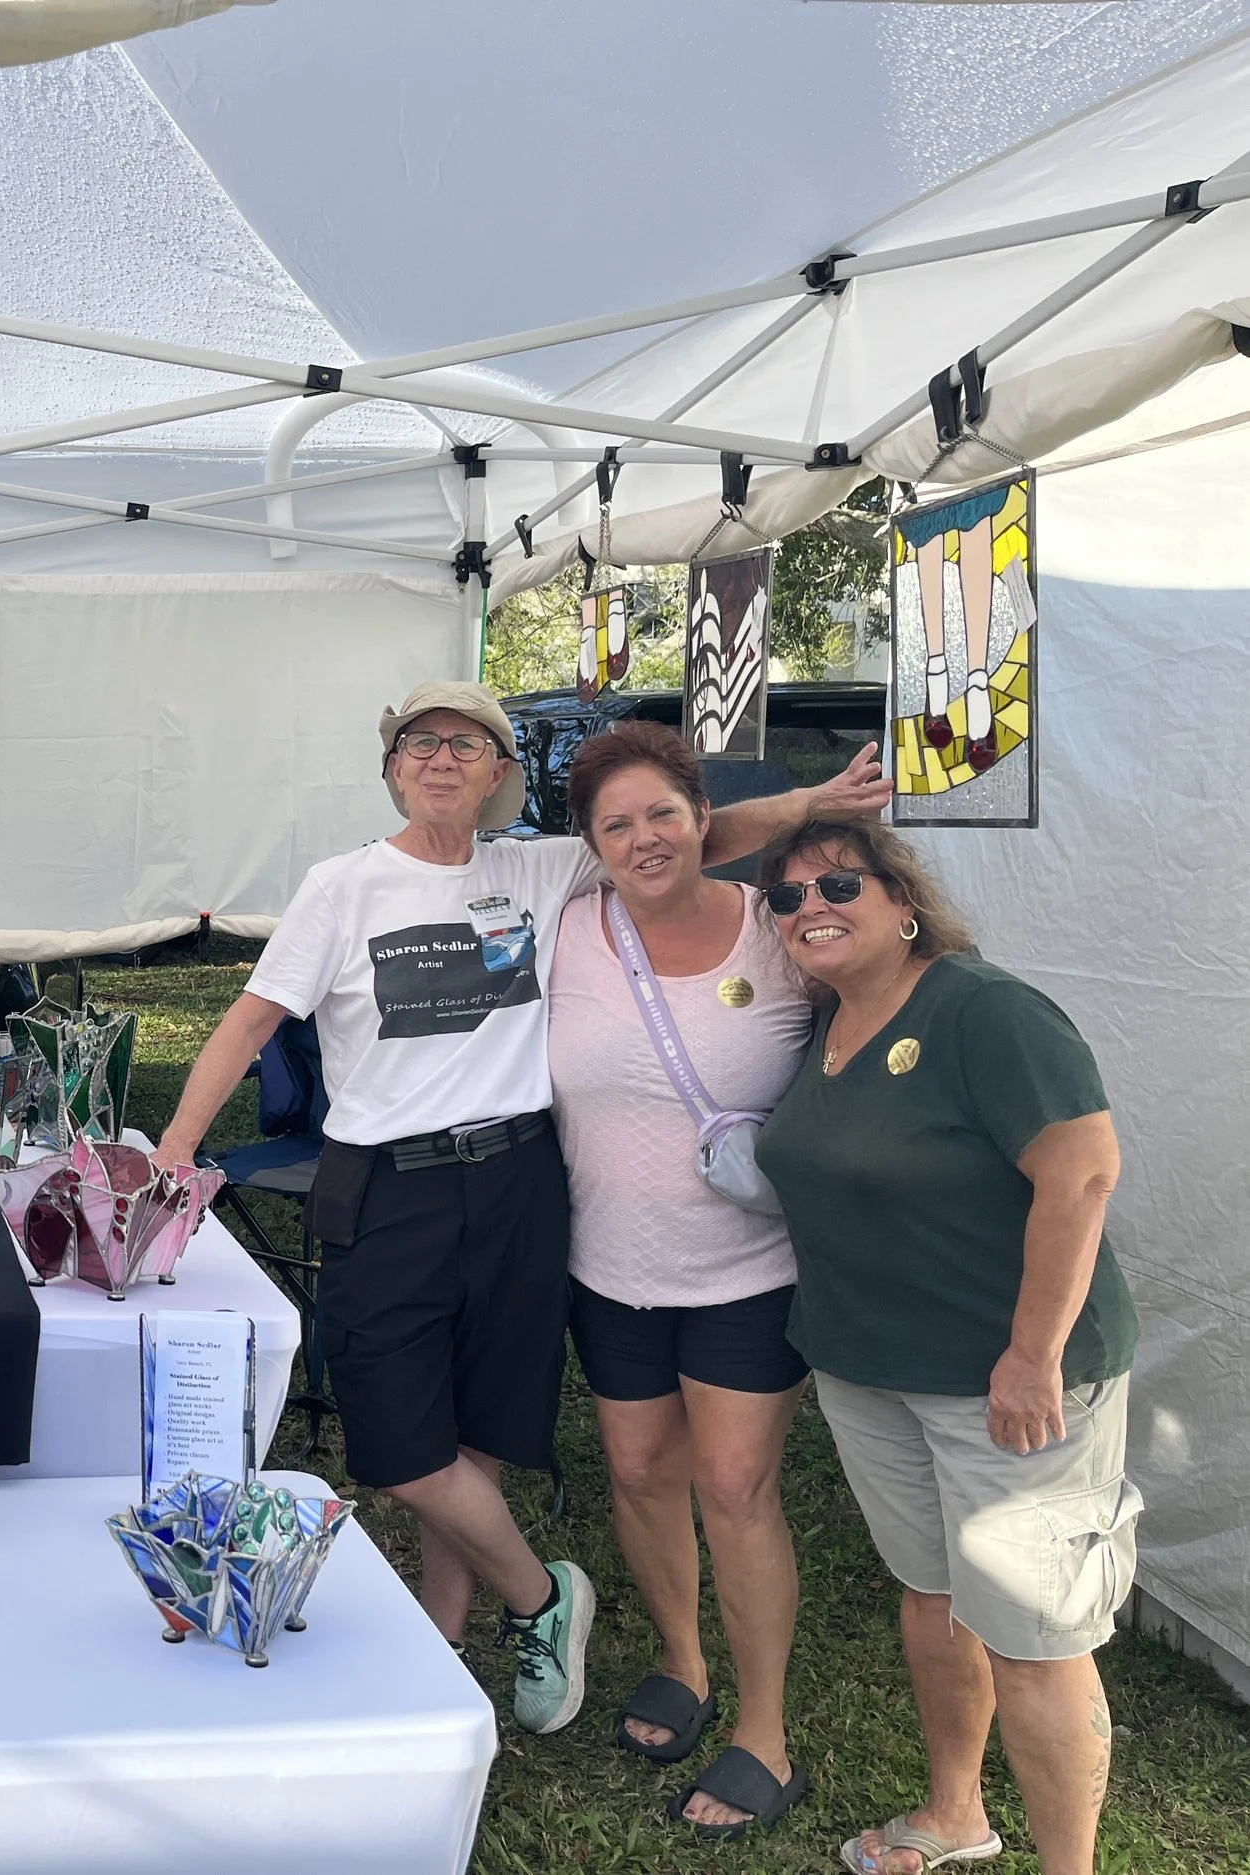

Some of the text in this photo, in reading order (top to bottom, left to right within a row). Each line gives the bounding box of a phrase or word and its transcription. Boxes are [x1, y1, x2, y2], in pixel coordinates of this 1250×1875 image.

[376, 941, 477, 961] Sharon Sedlar
[418, 960, 443, 968] Artist
[385, 1000, 432, 1012] Stained
[436, 998, 466, 1007] Glass
[470, 995, 481, 1004] of
[197, 1341, 222, 1349] Sedlar
[177, 1381, 211, 1389] Distinction
[167, 1409, 192, 1417] Original
[167, 1416, 189, 1425] Quality
[167, 1426, 200, 1434] Reasonable
[167, 1458, 190, 1466] Repairs
